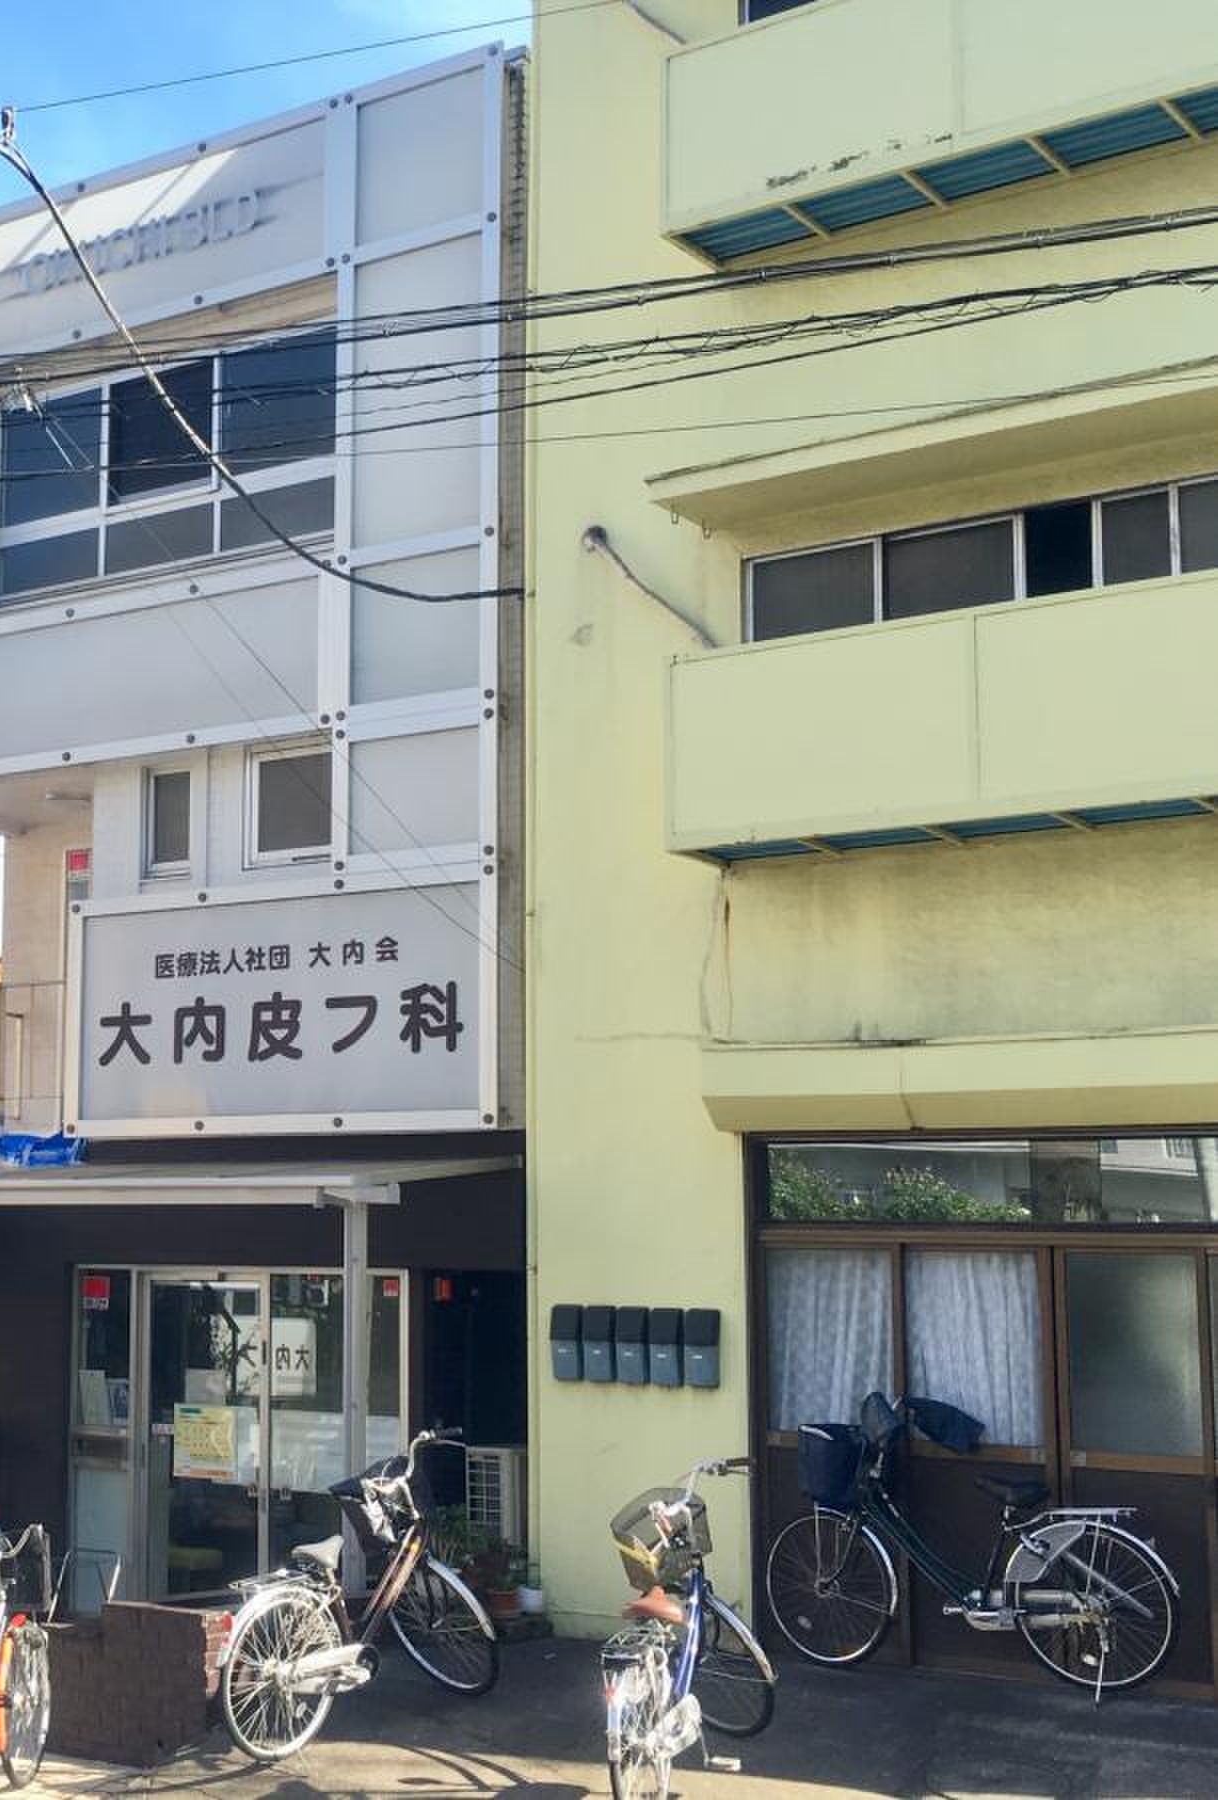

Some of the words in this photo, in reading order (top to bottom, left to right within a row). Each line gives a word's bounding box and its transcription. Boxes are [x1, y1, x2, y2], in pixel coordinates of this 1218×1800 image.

[154, 944, 291, 979] 医療法人社団
[308, 936, 399, 969] 大内会
[98, 980, 464, 1067] 大内皮フ科
